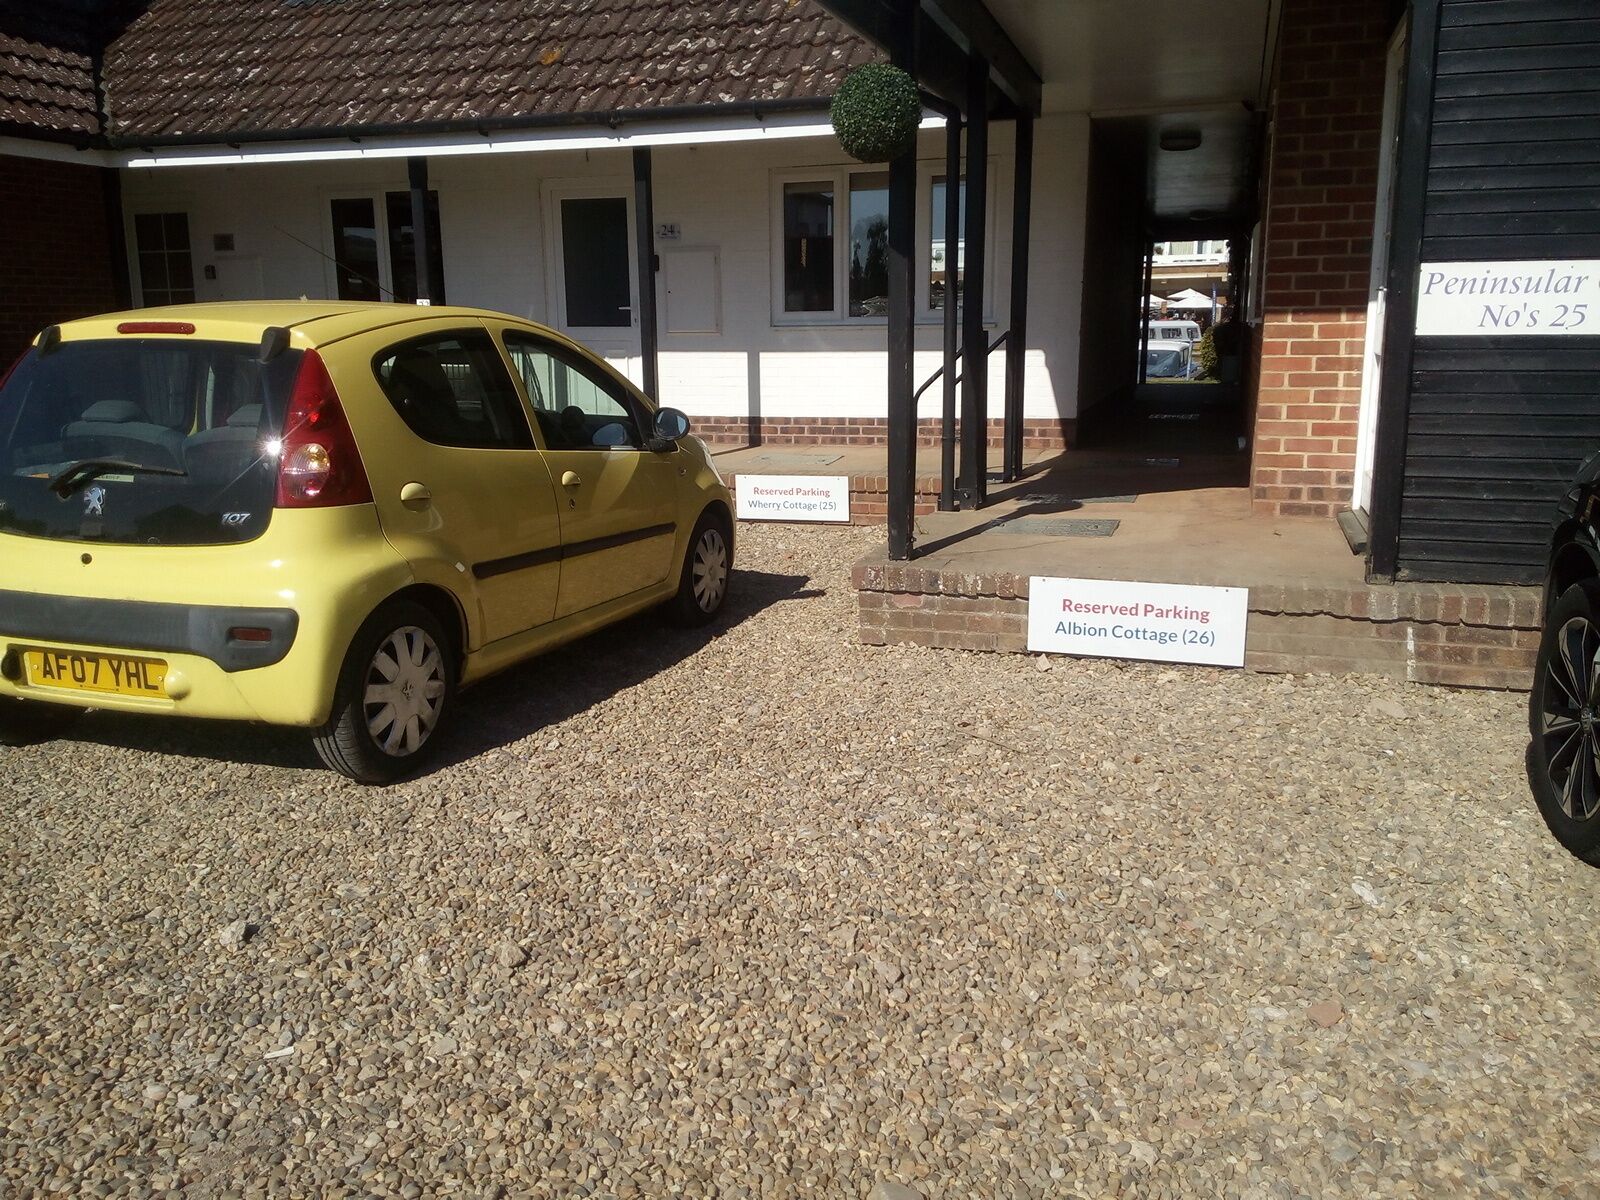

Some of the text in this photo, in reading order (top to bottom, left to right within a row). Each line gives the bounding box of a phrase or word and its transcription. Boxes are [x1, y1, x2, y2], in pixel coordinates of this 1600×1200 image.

[661, 224, 675, 236] 24
[1423, 268, 1589, 295] Peninsular
[1478, 302, 1588, 328] No's 25
[753, 486, 831, 498] Reserved Parking
[748, 500, 837, 511] Wherry Cottage (25)
[221, 512, 250, 526] 107
[1062, 599, 1211, 624] Reserved Parking
[1055, 621, 1216, 647] Albion Cottage (26)
[43, 651, 159, 690] AF07 YHL
